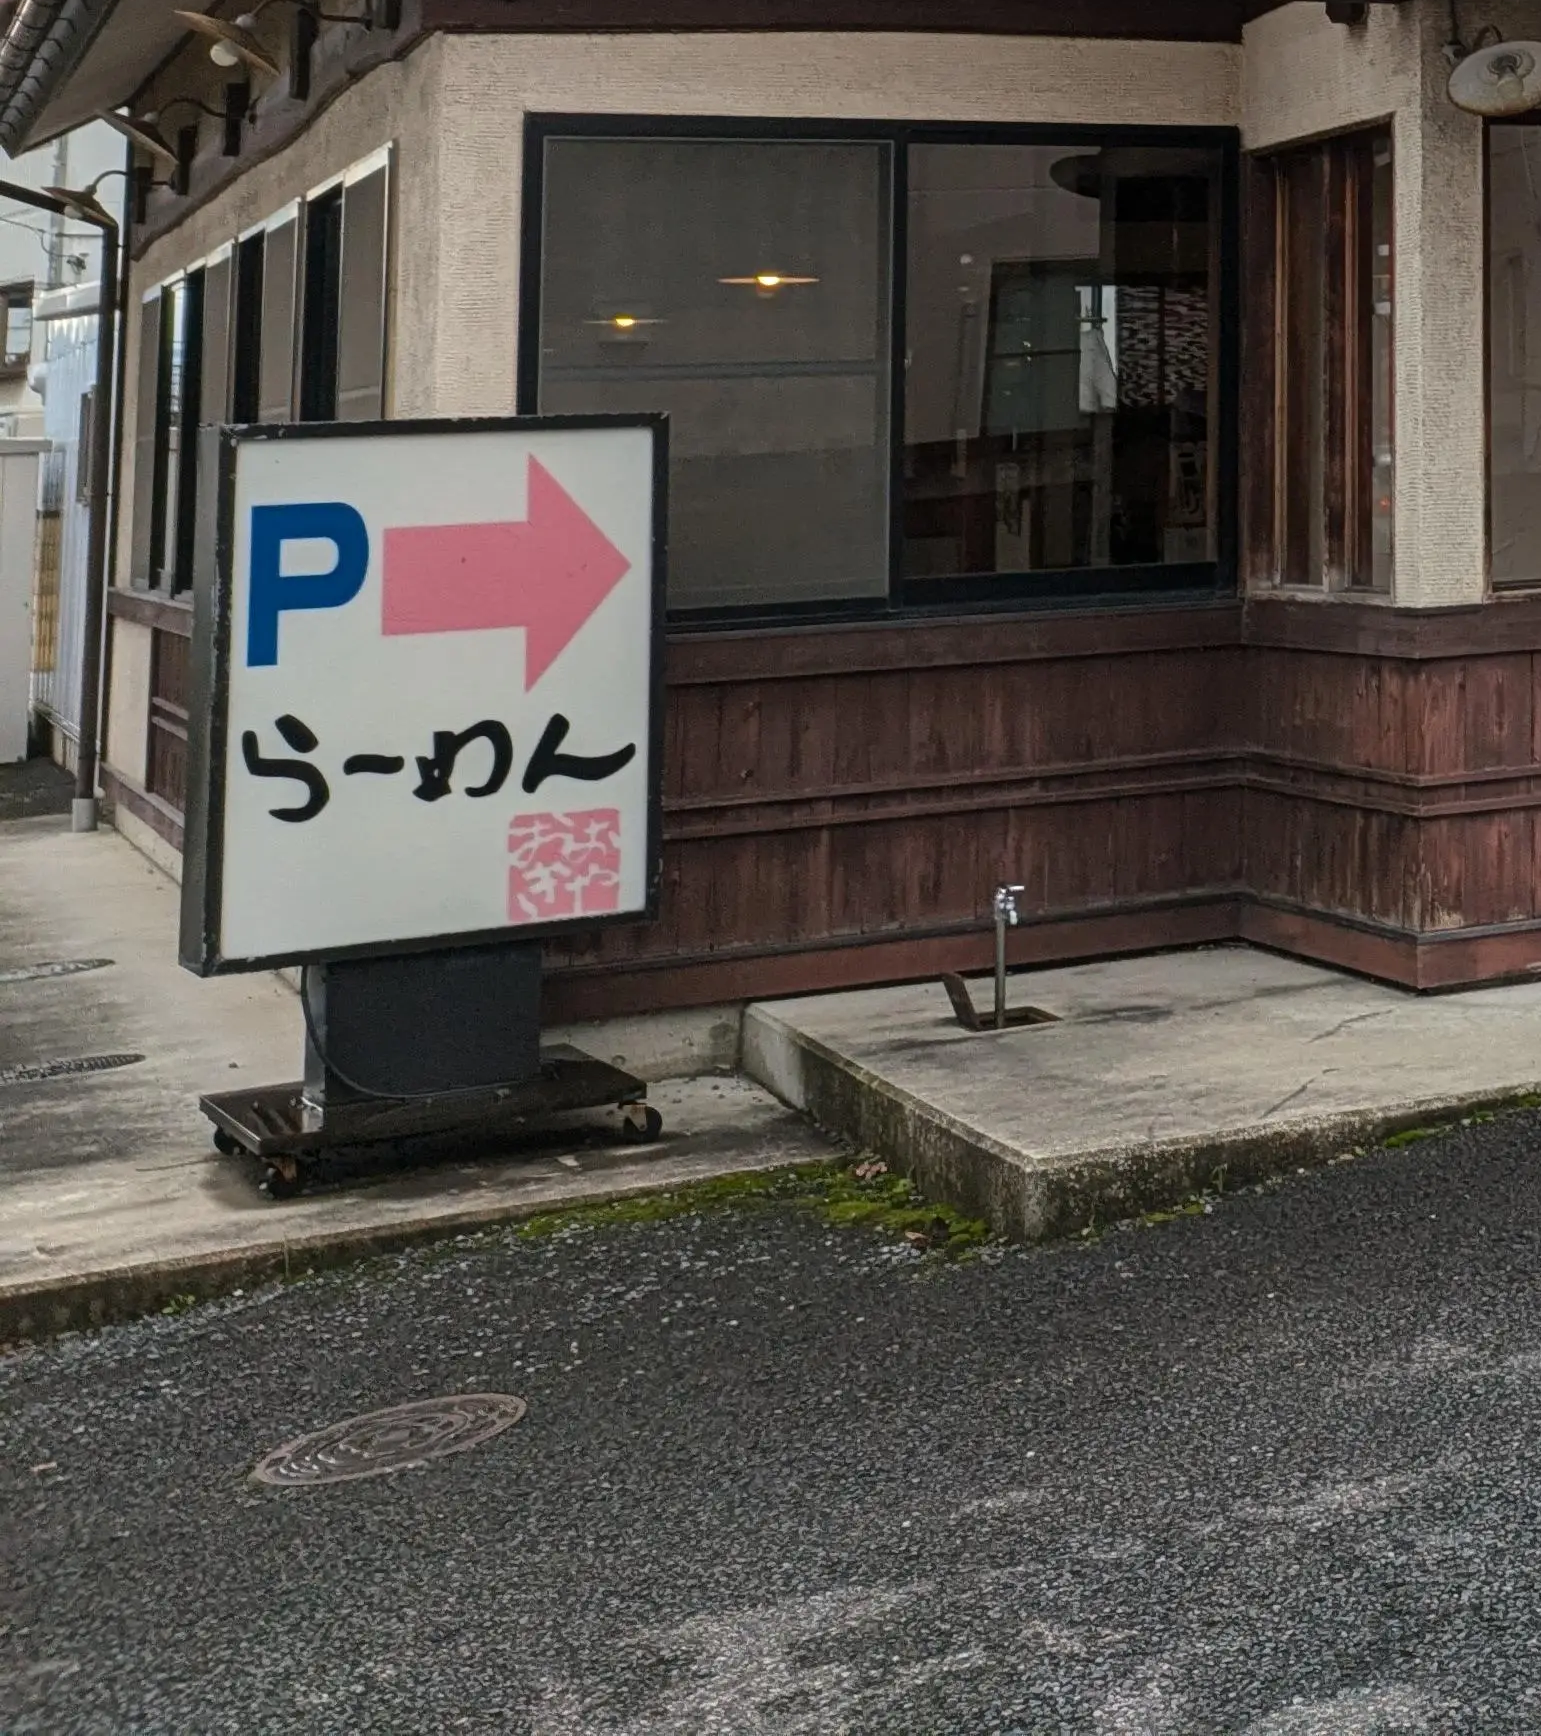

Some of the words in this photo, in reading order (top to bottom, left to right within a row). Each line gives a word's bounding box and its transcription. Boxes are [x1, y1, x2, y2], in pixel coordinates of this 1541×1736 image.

[247, 502, 369, 667] P
[241, 712, 637, 823] らーめん
